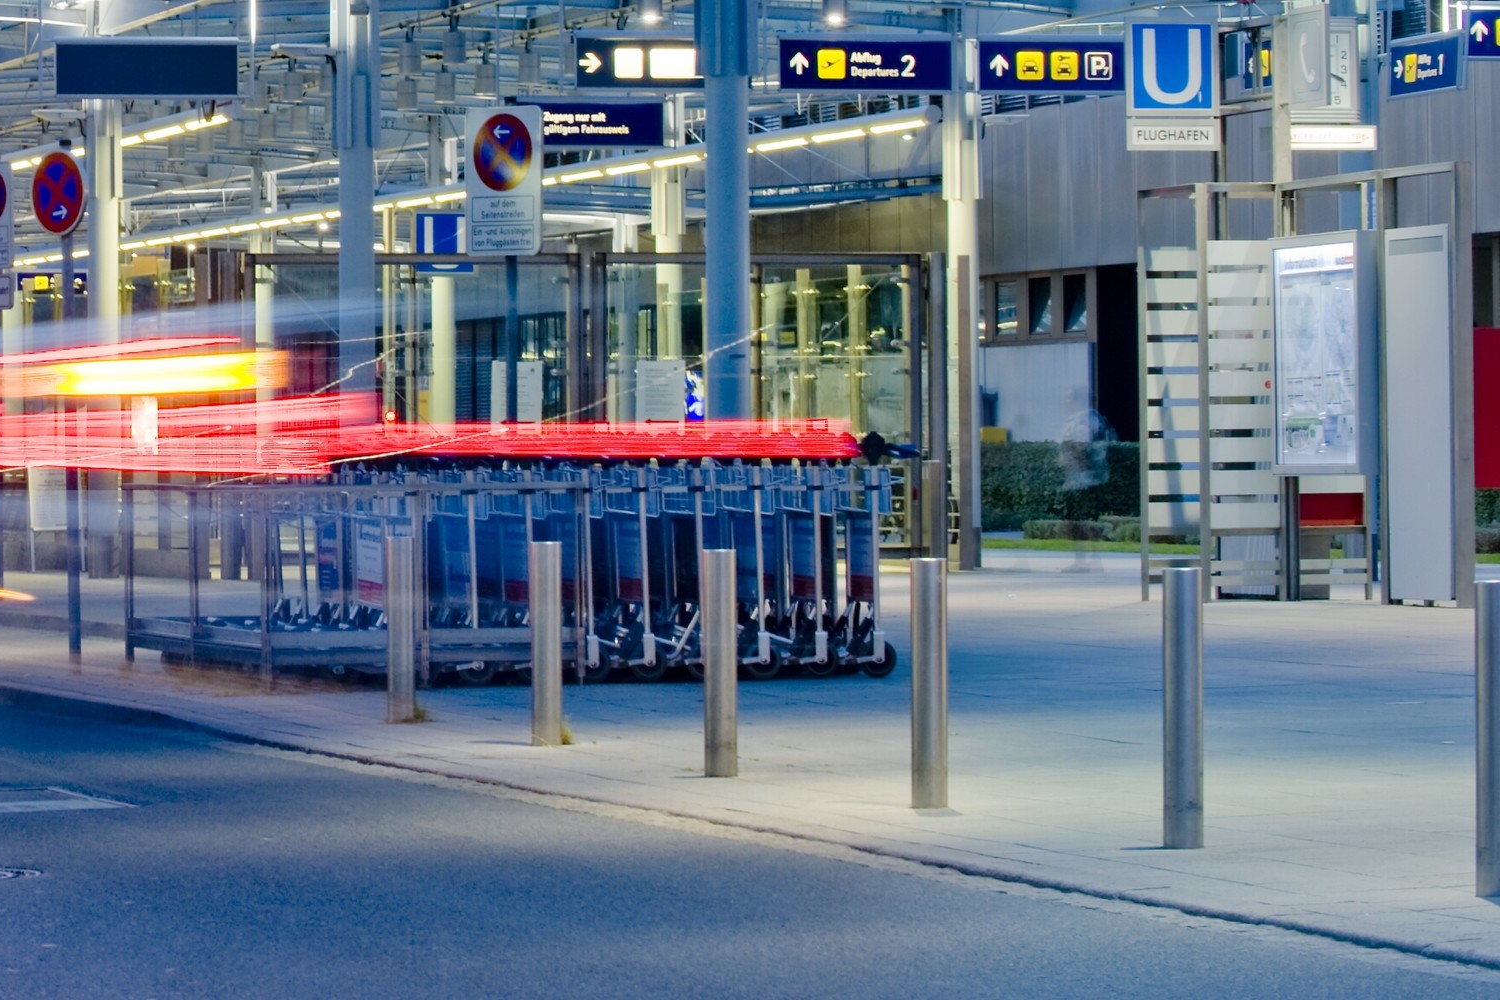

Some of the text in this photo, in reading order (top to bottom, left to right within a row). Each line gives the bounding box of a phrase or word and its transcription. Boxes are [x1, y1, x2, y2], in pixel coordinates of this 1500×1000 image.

[1334, 35, 1339, 44] 1
[850, 51, 882, 66] Abflug
[1341, 50, 1348, 60] 2
[900, 54, 916, 77] 2
[1142, 28, 1202, 105] U
[1341, 64, 1348, 75] 3
[850, 66, 900, 79] Departures
[1334, 95, 1342, 105] 5
[543, 112, 606, 124] Zugang nur mit
[543, 124, 630, 136] gültigem Fahrausweis
[1137, 129, 1210, 141] FLUGHAFEN
[490, 199, 516, 208] auf dem
[480, 209, 525, 220] Seitenstreifen
[473, 227, 483, 237] Ein
[500, 226, 533, 238] Aussteigen
[474, 239, 485, 247] von
